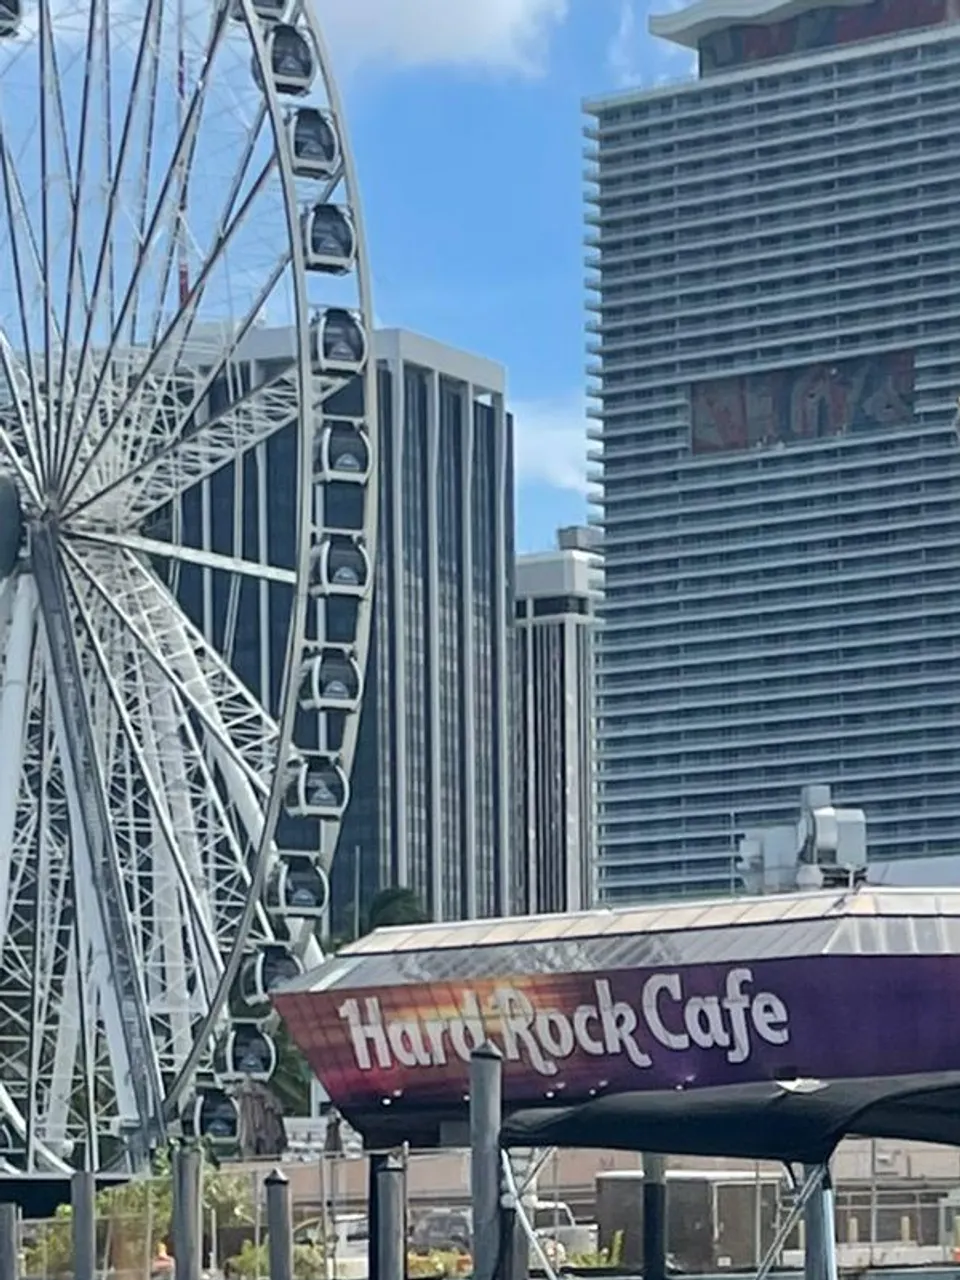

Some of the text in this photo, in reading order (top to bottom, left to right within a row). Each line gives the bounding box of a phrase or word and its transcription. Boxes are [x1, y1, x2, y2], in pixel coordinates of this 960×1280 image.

[338, 967, 790, 1076] Hard Rock Cafe
